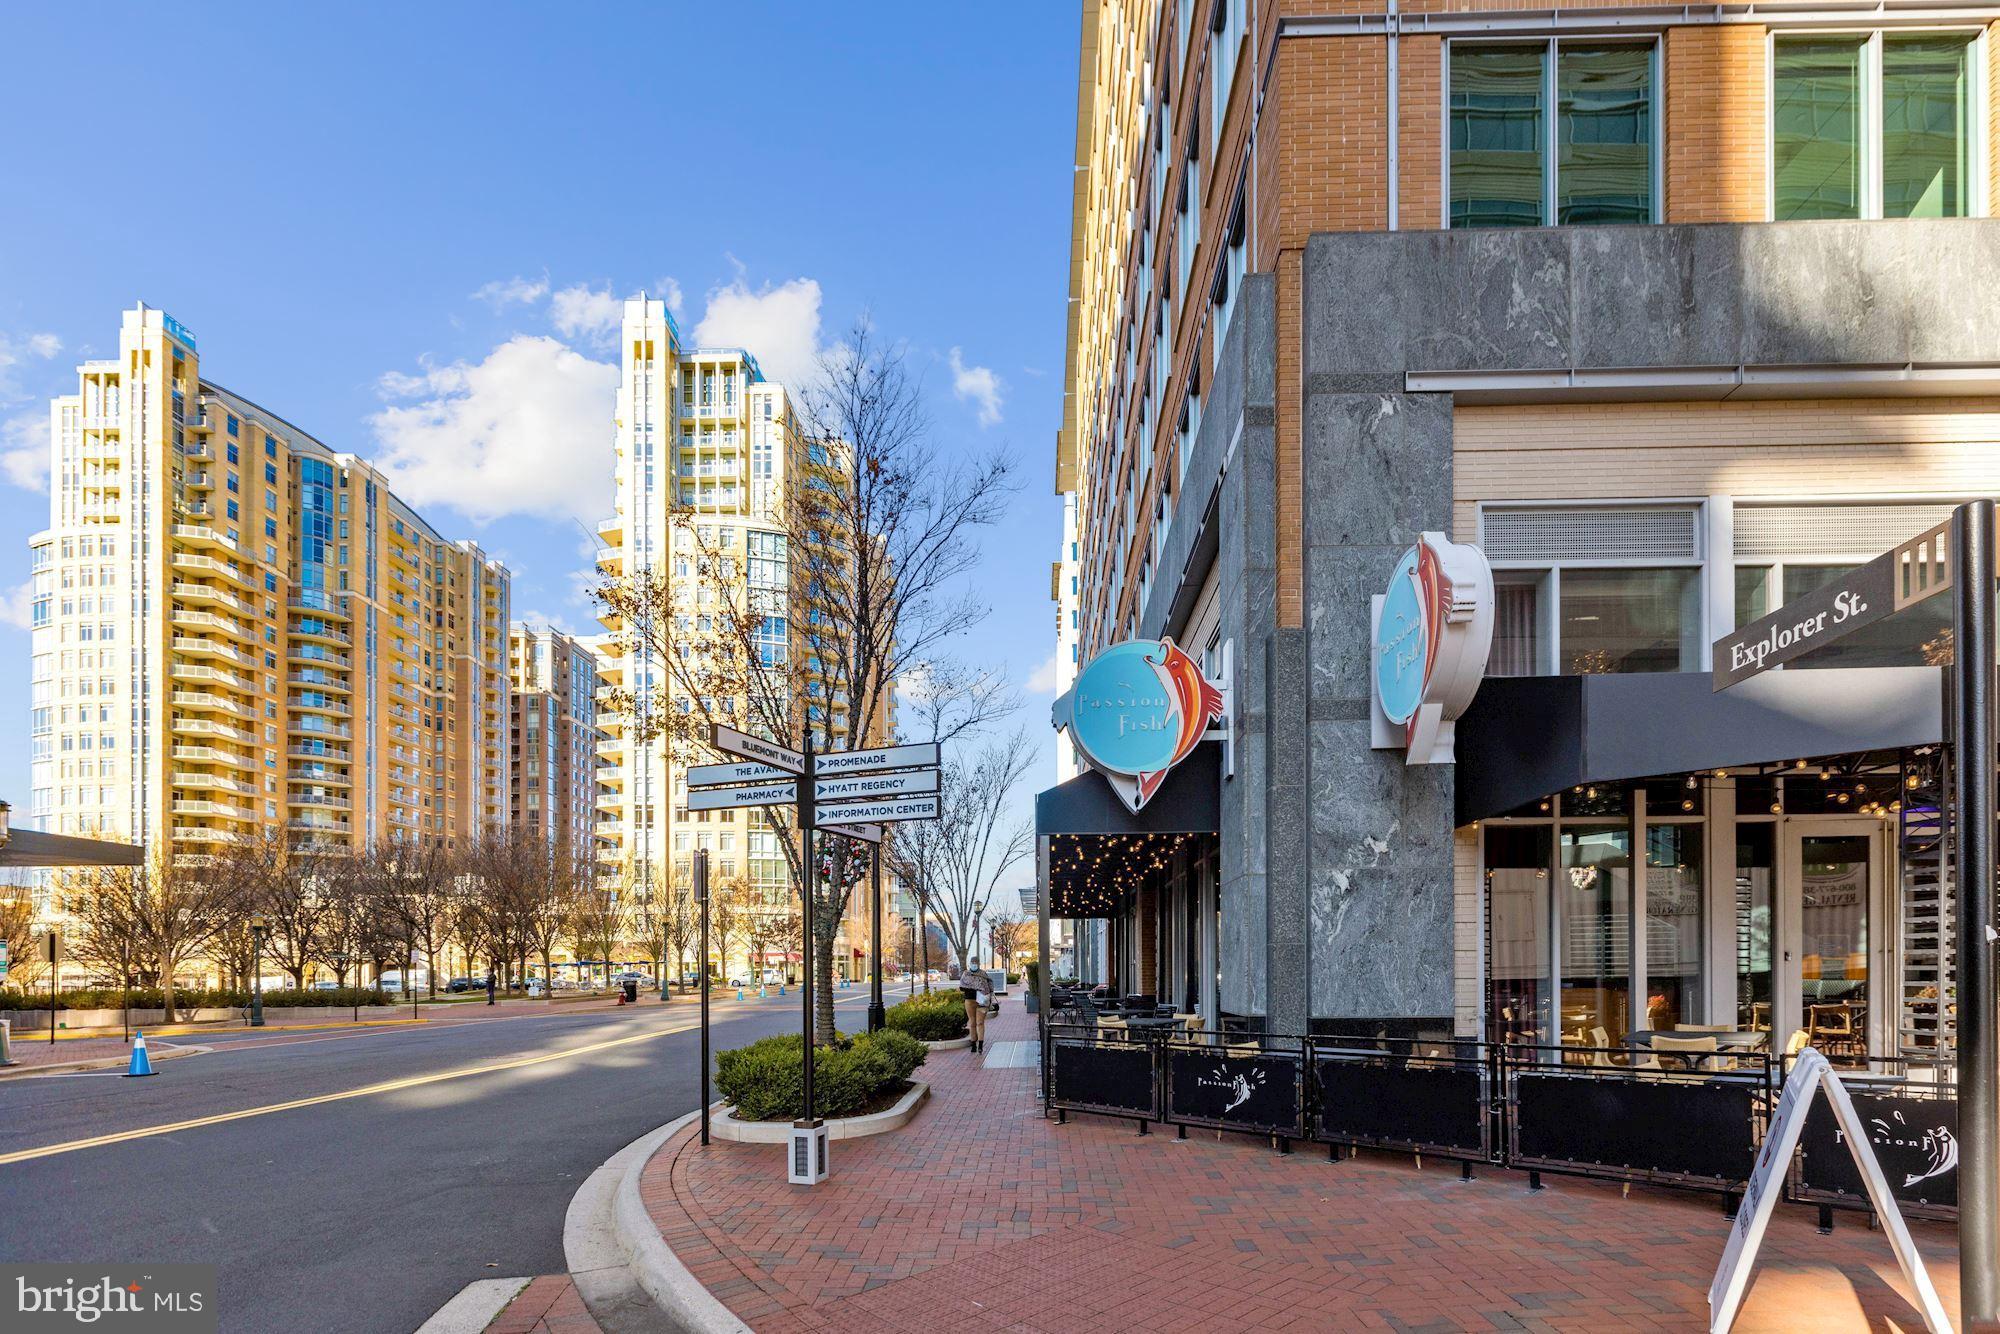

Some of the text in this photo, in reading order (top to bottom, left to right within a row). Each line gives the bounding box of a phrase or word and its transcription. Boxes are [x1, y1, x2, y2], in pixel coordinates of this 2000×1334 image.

[1730, 590, 1868, 671] Explorer St.
[1078, 693, 1166, 715] Passion
[1118, 714, 1162, 739] Fish
[742, 740, 796, 765] BLUEMONT WAY
[828, 755, 886, 768] PROMENADE
[735, 767, 752, 776] THE
[828, 779, 905, 793] HYATT REGENCY
[735, 789, 783, 801] PHARMACY
[828, 803, 935, 819] INFORMATION CENTER
